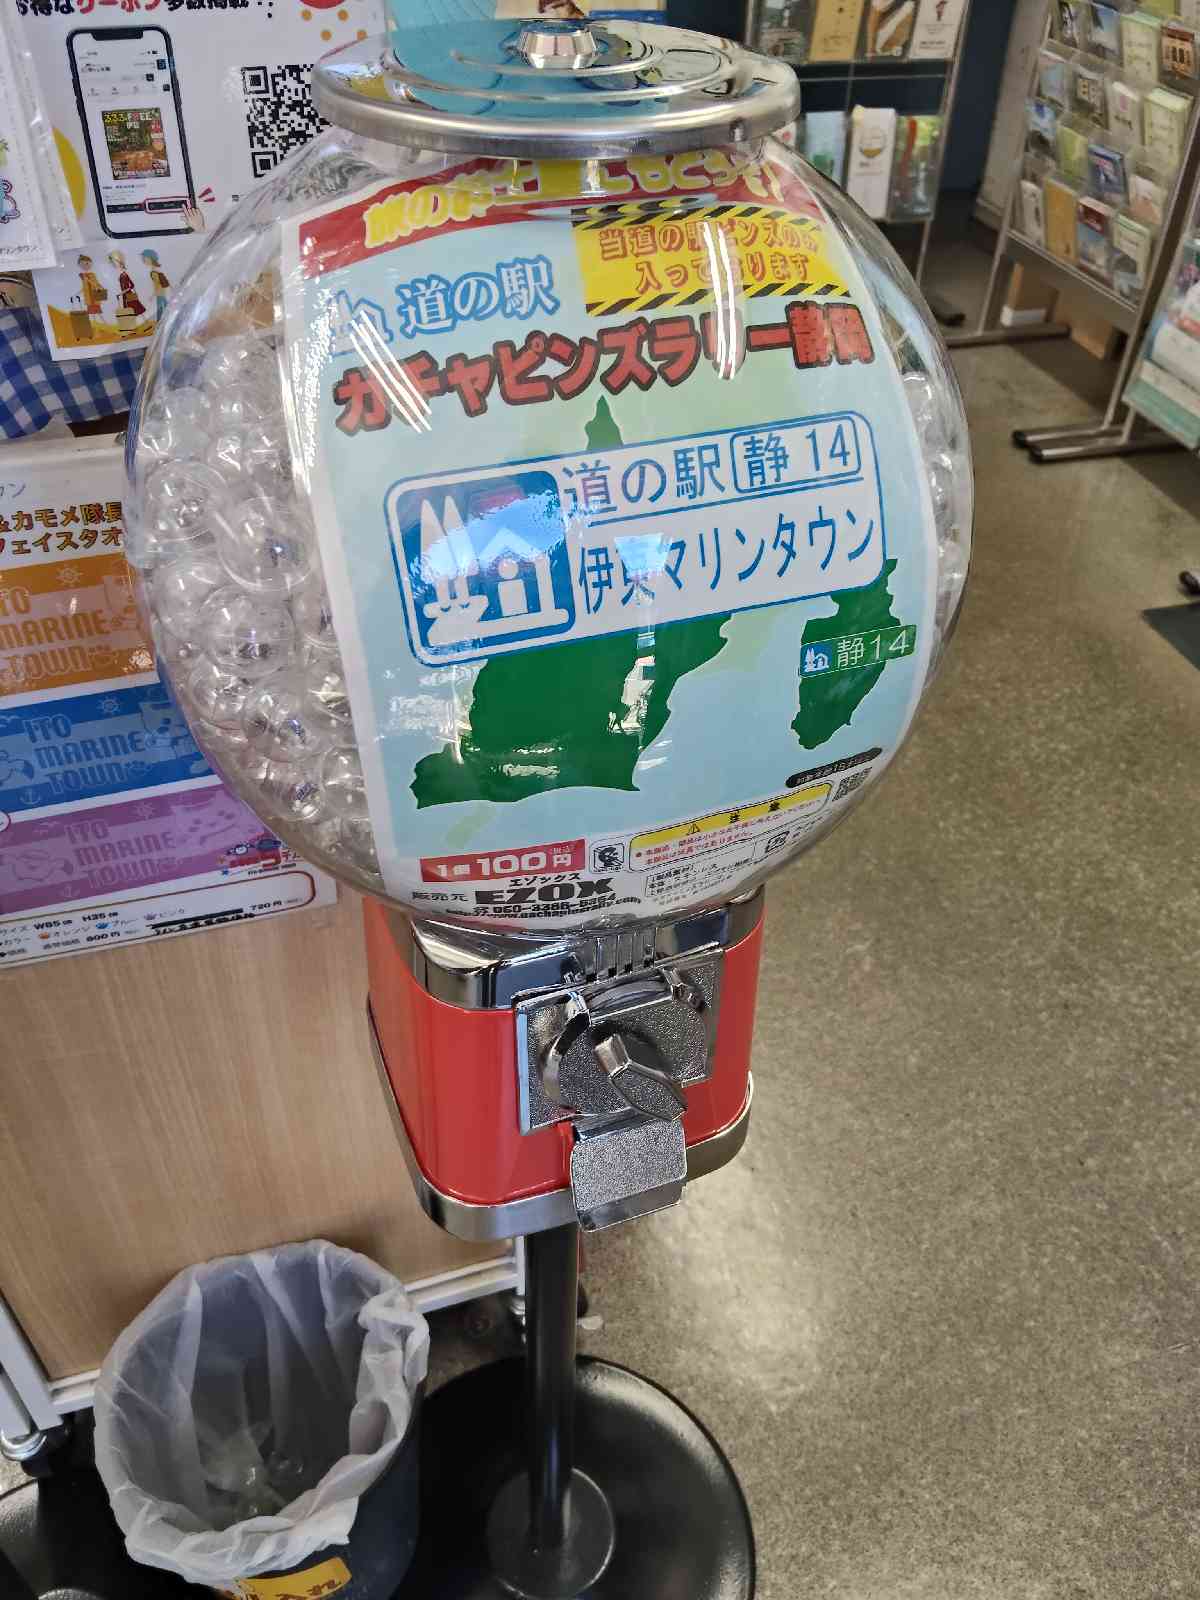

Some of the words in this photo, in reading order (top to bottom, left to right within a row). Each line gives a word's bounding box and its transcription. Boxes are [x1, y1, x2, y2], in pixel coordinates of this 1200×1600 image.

[394, 254, 561, 340] 道の駅
[561, 443, 726, 513] 道の駅
[743, 432, 790, 487] 静
[805, 423, 851, 472] 14
[24, 713, 72, 744] ITO
[34, 730, 146, 770] MARINE
[45, 762, 128, 796] TOWN
[65, 819, 109, 845] ITO
[73, 831, 176, 866] MARINE
[475, 877, 617, 905] EZOX
[508, 872, 581, 888] エゾックス
